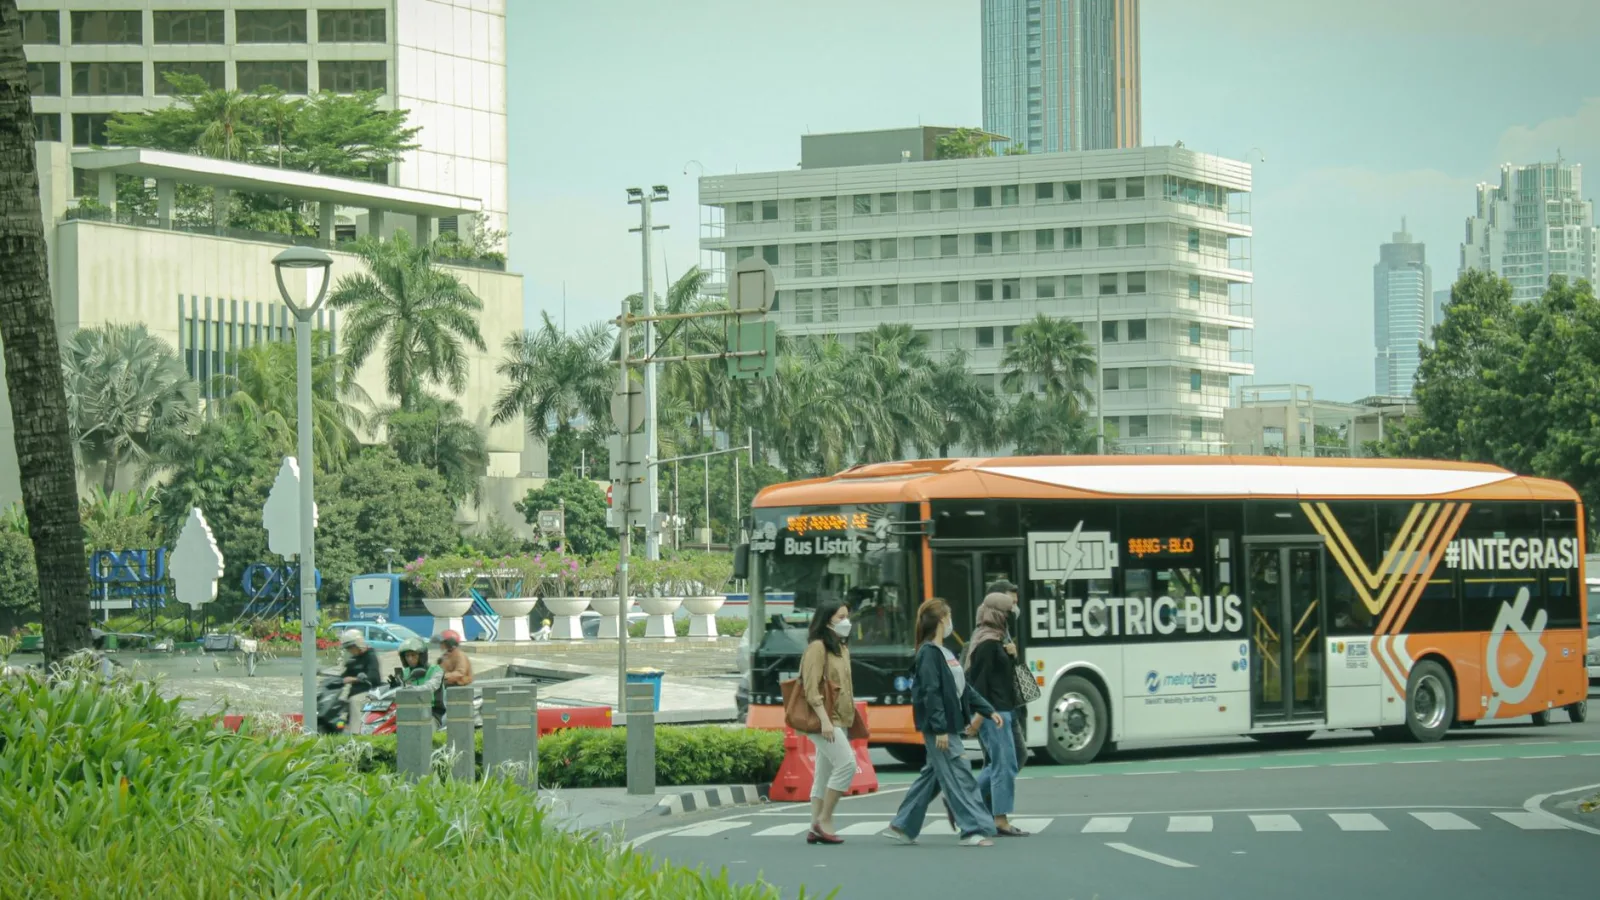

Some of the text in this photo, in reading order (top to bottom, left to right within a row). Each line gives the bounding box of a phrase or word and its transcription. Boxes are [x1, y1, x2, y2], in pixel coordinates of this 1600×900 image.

[784, 537, 812, 556] Bus
[815, 536, 862, 555] Listrik
[1445, 537, 1579, 570] #INTEGRASI
[1030, 594, 1243, 639] ELECTRIC BUS
[1163, 672, 1217, 688] metrotrans
